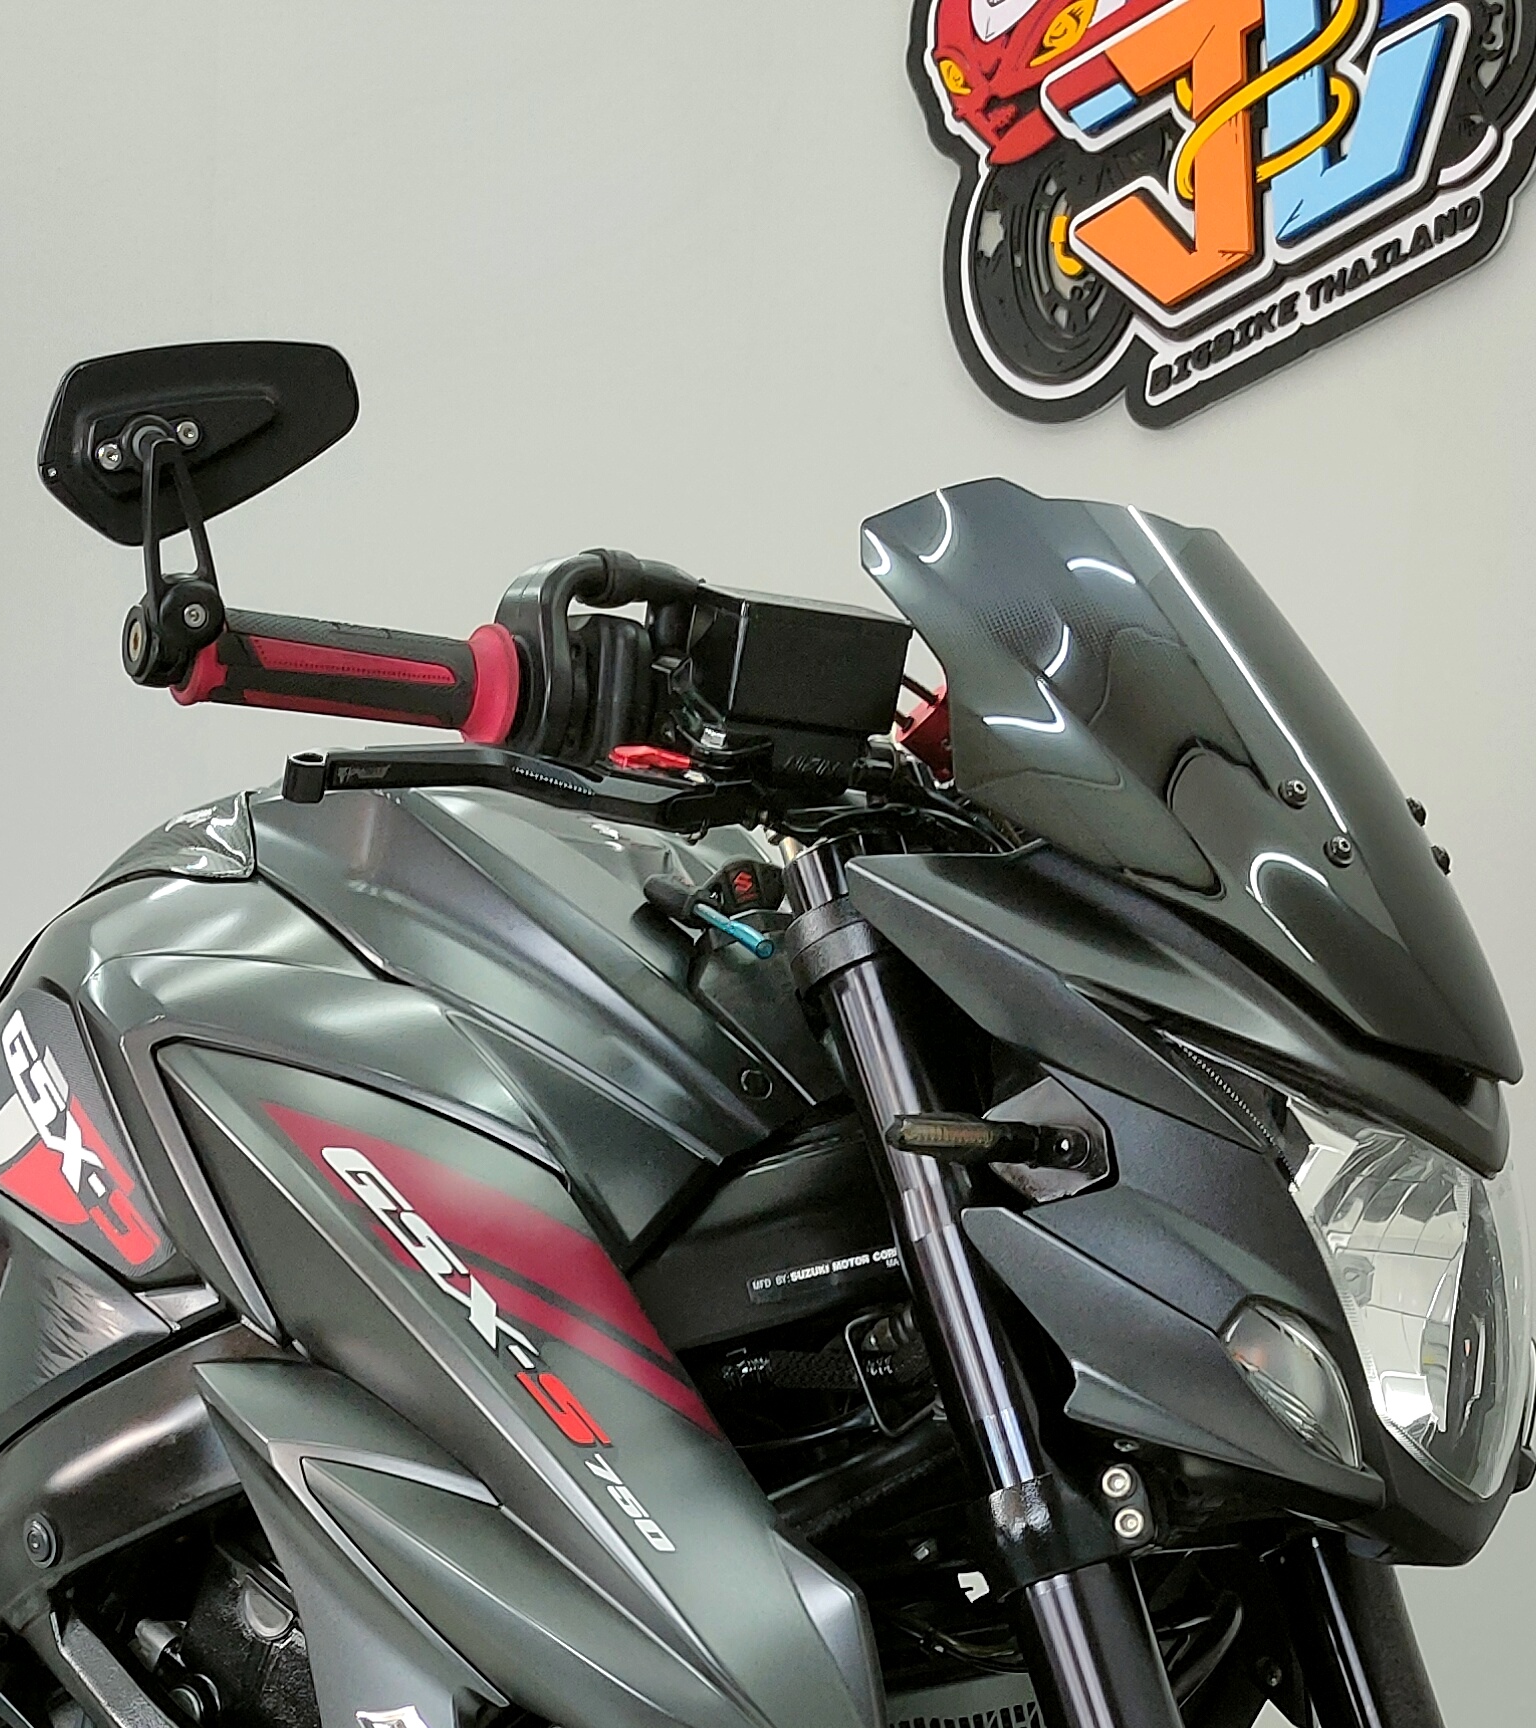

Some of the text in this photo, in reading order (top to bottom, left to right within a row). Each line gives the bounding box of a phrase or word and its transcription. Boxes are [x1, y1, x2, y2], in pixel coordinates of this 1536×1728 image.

[1148, 196, 1482, 397] BIGBIKE THAILAND
[1, 1008, 161, 1267] GSX-S
[321, 1147, 676, 1552] GSX-S 750
[752, 1277, 772, 1291] MFD
[831, 1253, 870, 1273] MOTOR
